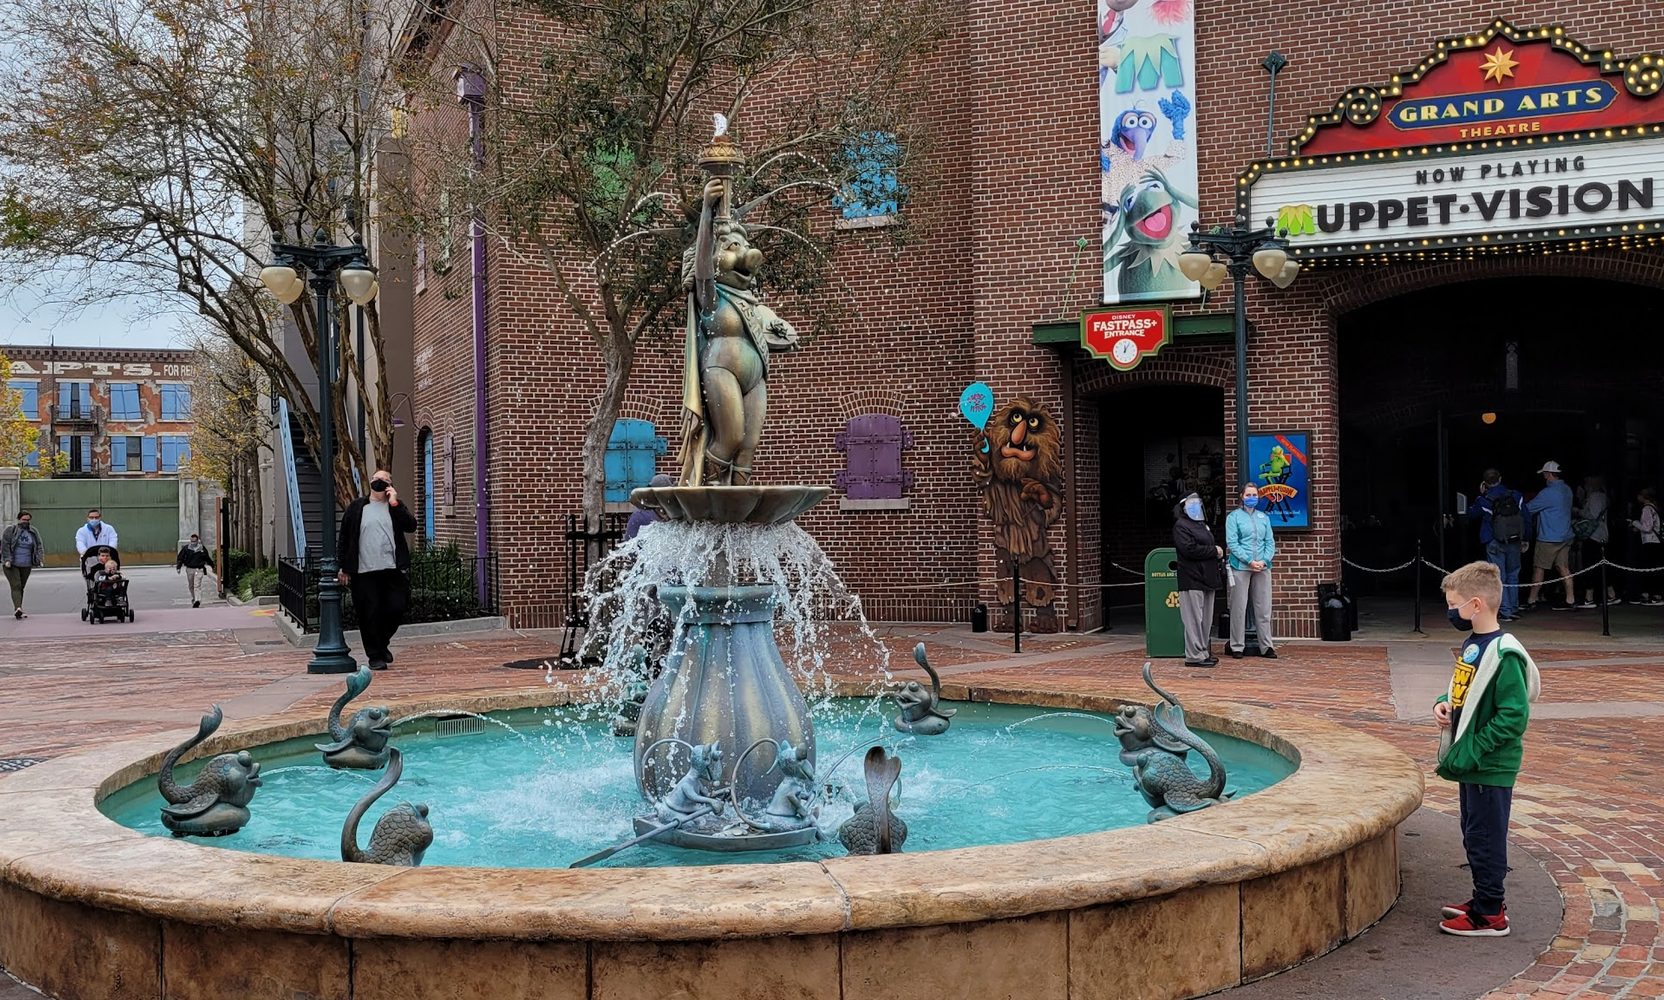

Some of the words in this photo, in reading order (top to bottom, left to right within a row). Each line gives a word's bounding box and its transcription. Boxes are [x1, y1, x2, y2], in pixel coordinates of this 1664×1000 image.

[1400, 98, 1505, 123] GRAND
[1517, 87, 1603, 111] ARTS
[1460, 121, 1541, 139] THEATRE
[1416, 167, 1465, 185] NOW
[1481, 156, 1585, 179] PLAYING
[1093, 319, 1157, 332] FASTPASS+
[1104, 329, 1145, 339] ENTRANCE
[163, 364, 179, 376] FOR
